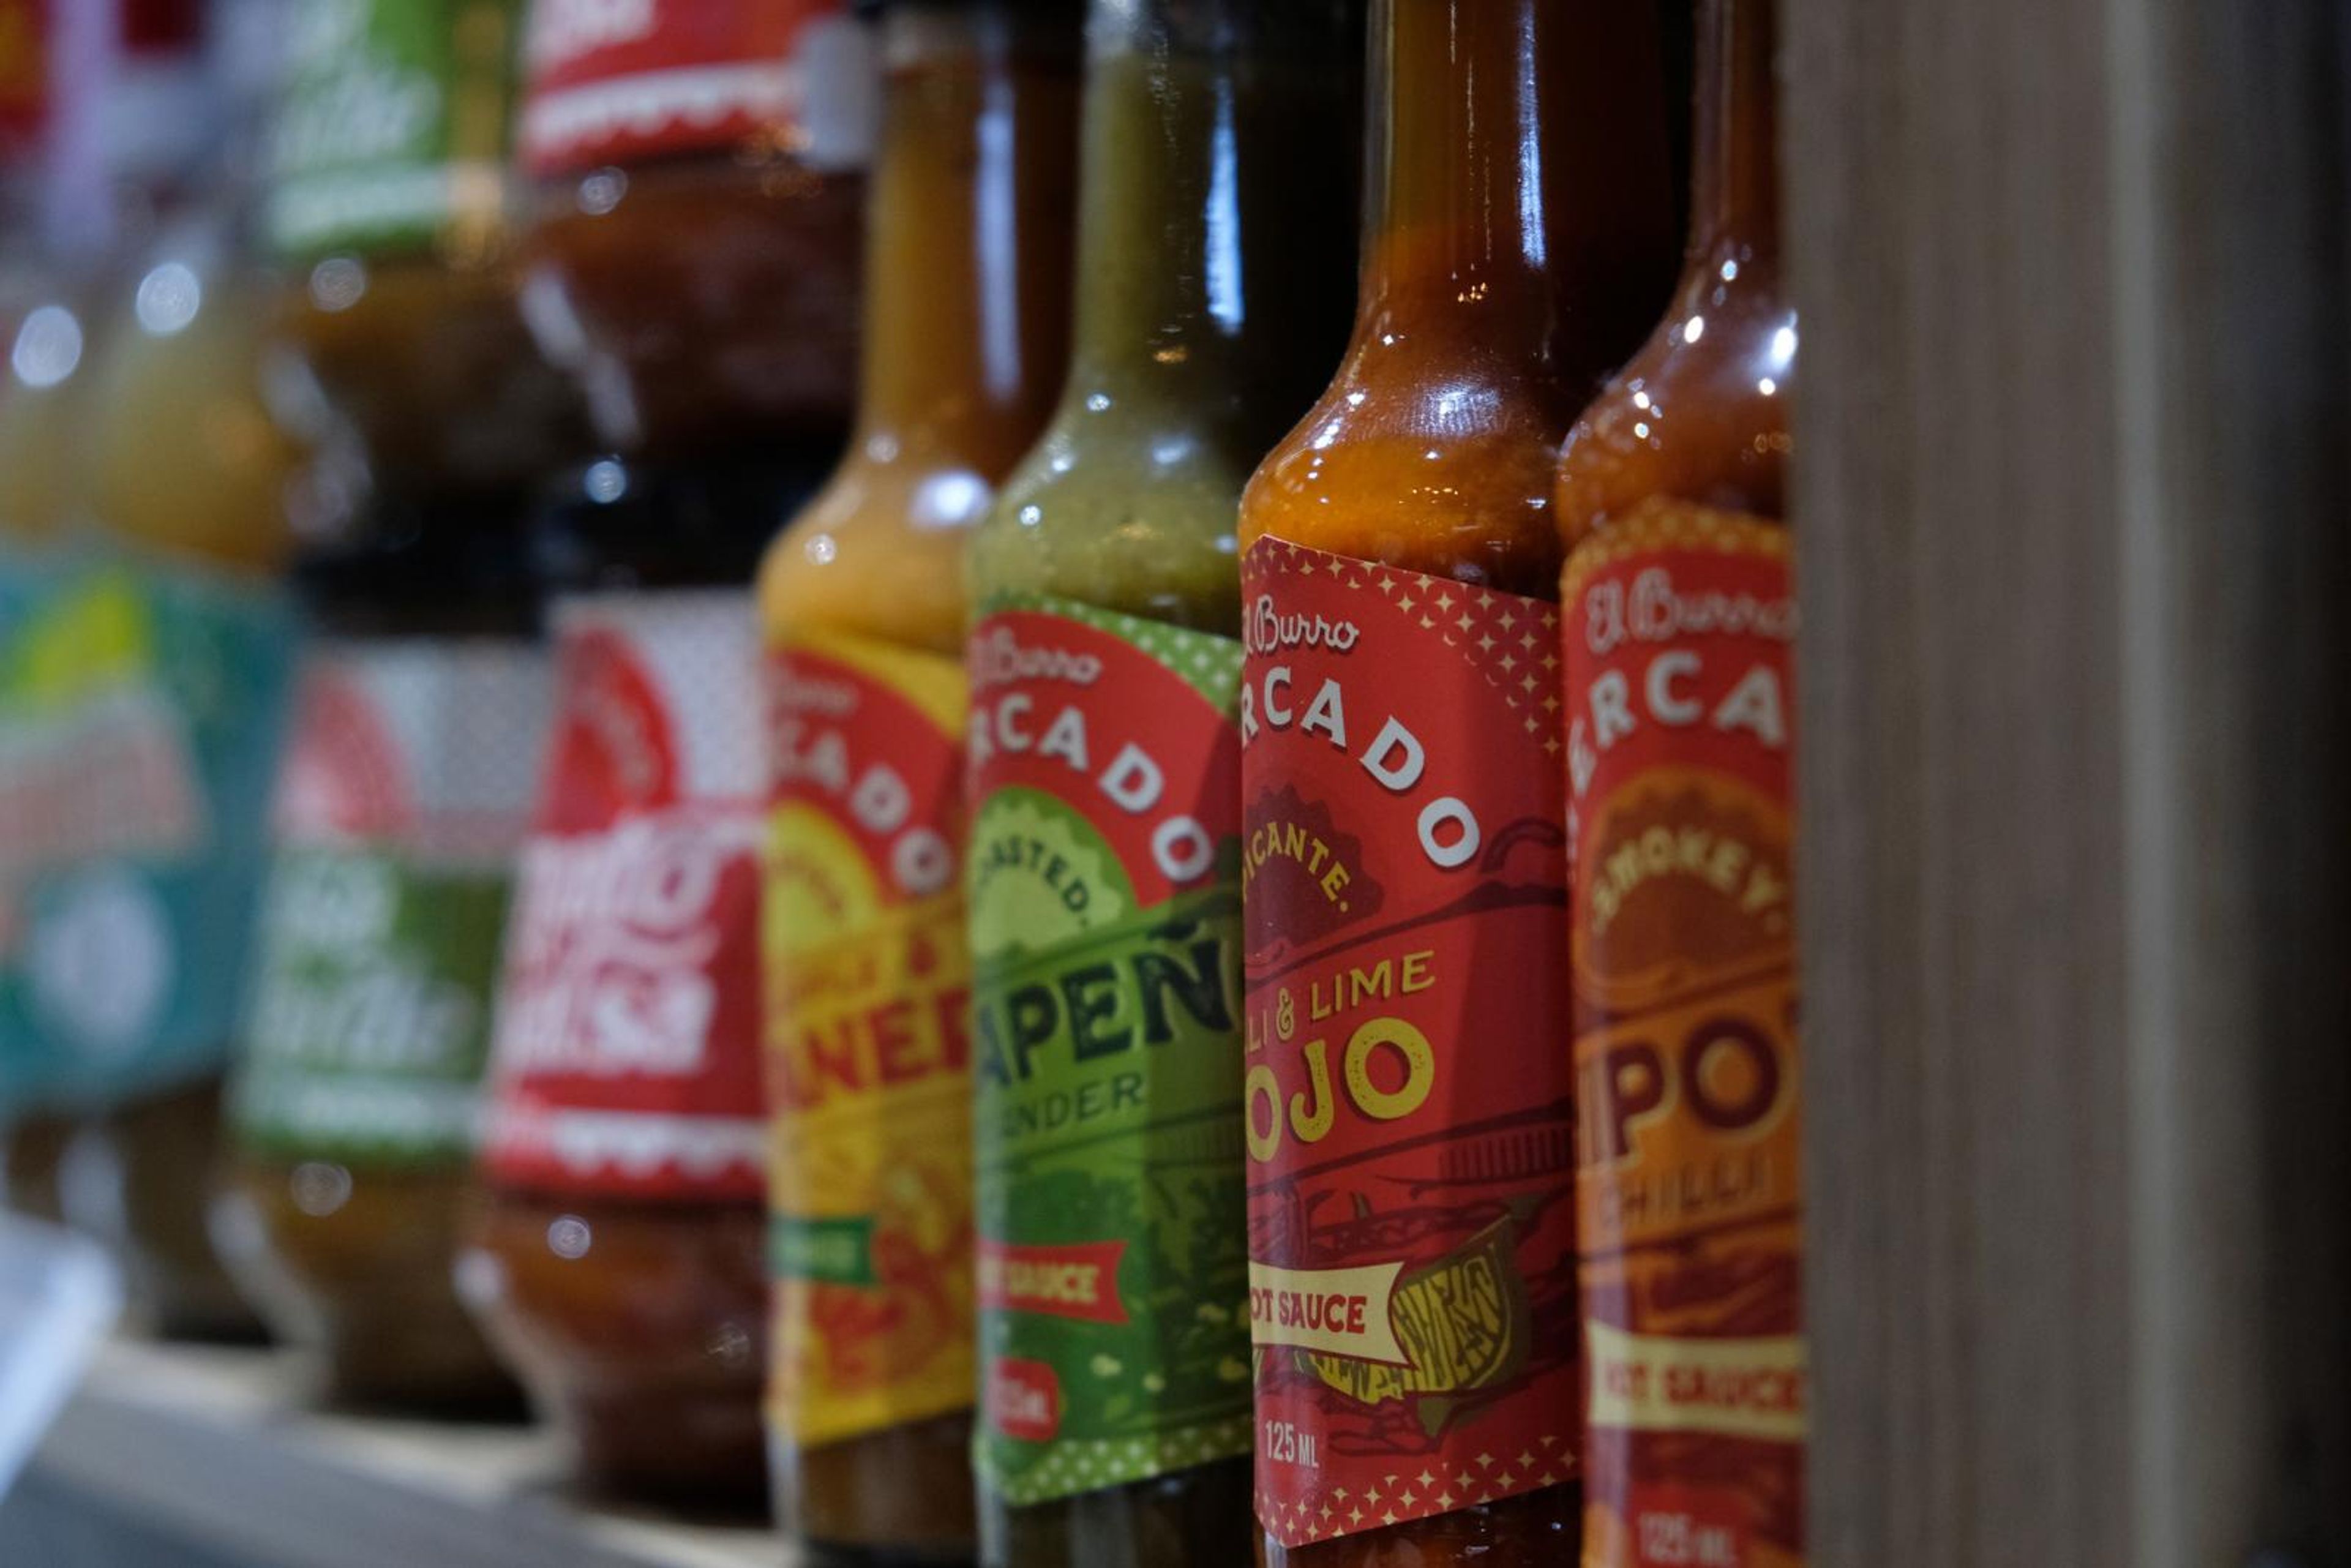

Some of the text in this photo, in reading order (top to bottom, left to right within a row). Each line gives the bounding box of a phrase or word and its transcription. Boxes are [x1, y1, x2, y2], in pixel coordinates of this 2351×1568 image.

[1254, 593, 1360, 653] Burro
[1277, 987, 1294, 1040] &
[1310, 950, 1435, 1021] LIME
[1245, 1016, 1435, 1162] OJO
[1278, 1291, 1367, 1334] SAUCE
[1265, 1420, 1319, 1468] 125 ML
